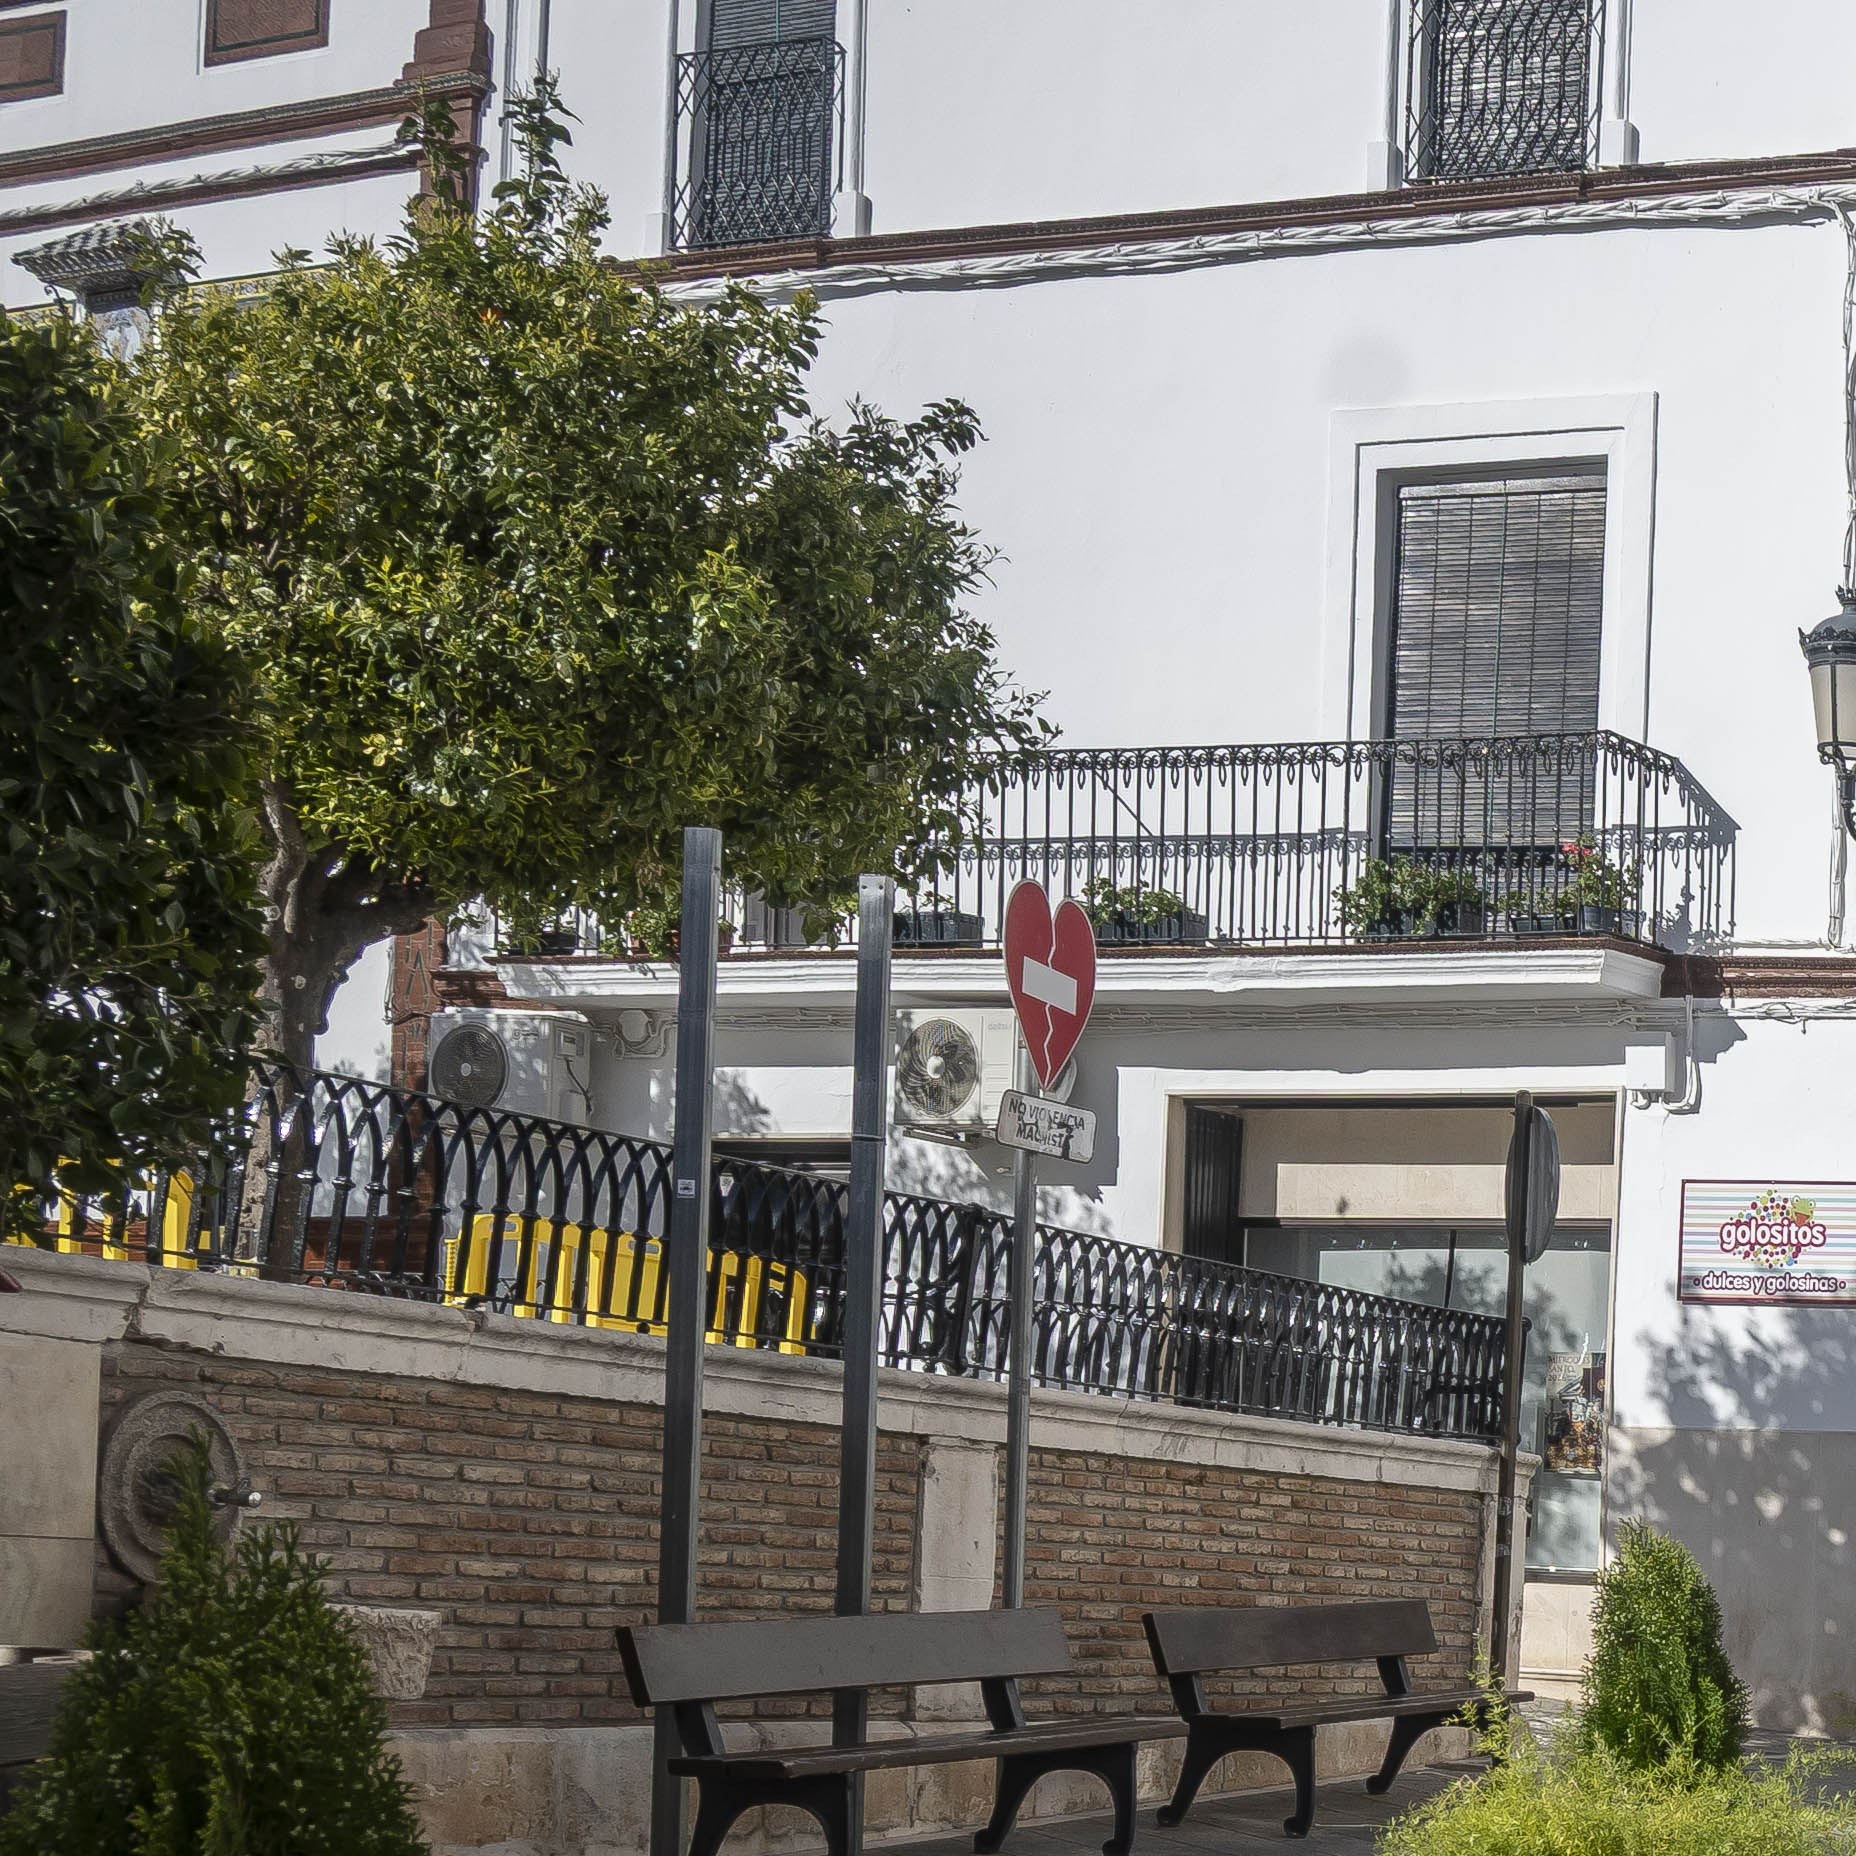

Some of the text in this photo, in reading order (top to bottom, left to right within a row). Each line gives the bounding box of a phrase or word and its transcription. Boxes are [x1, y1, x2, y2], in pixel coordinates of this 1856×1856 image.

[1009, 1098, 1026, 1116] NO
[1721, 1218, 1826, 1252] golositos
[1703, 1271, 1837, 1295] dulces y golosinas
